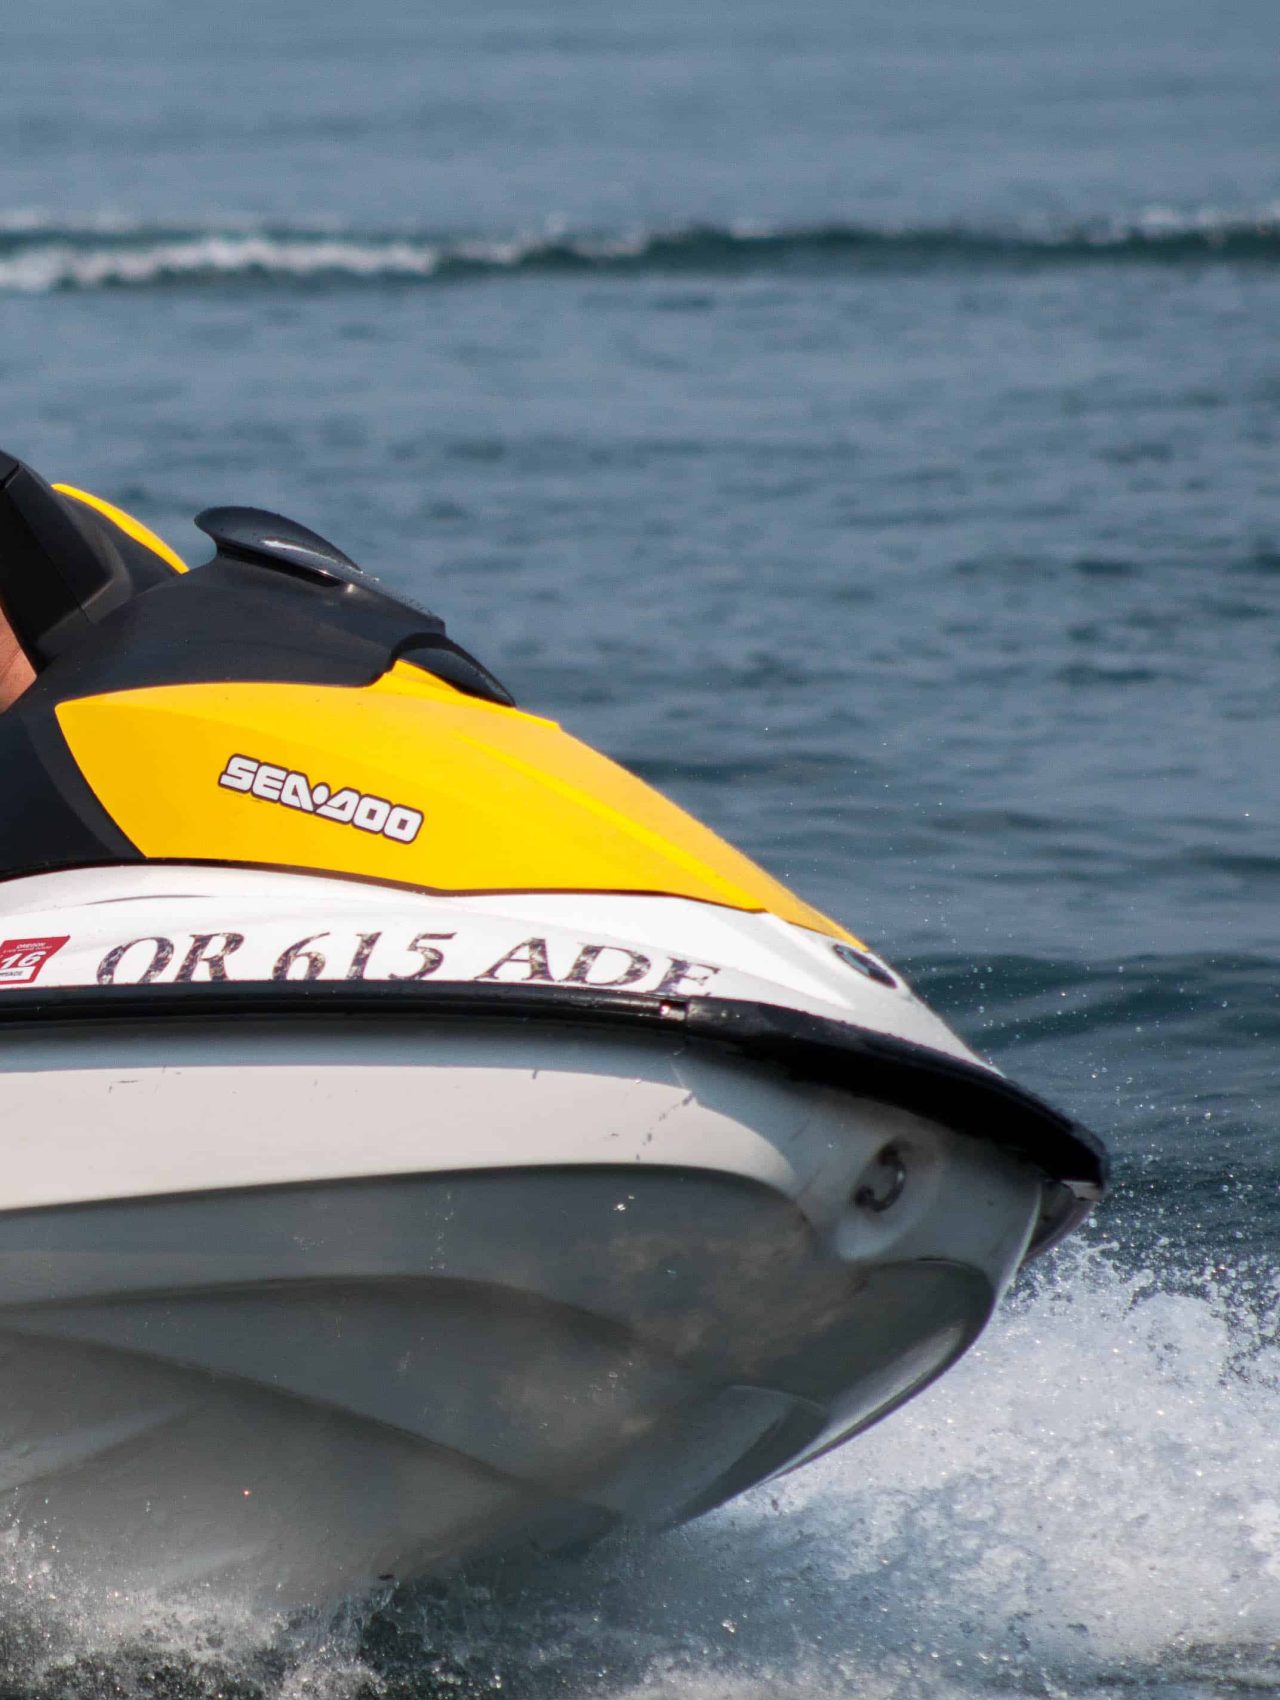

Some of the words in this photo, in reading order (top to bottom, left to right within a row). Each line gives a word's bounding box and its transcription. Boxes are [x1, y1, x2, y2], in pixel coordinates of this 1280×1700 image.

[0, 950, 47, 970] 16
[95, 931, 245, 986] OR
[271, 931, 458, 981] 615
